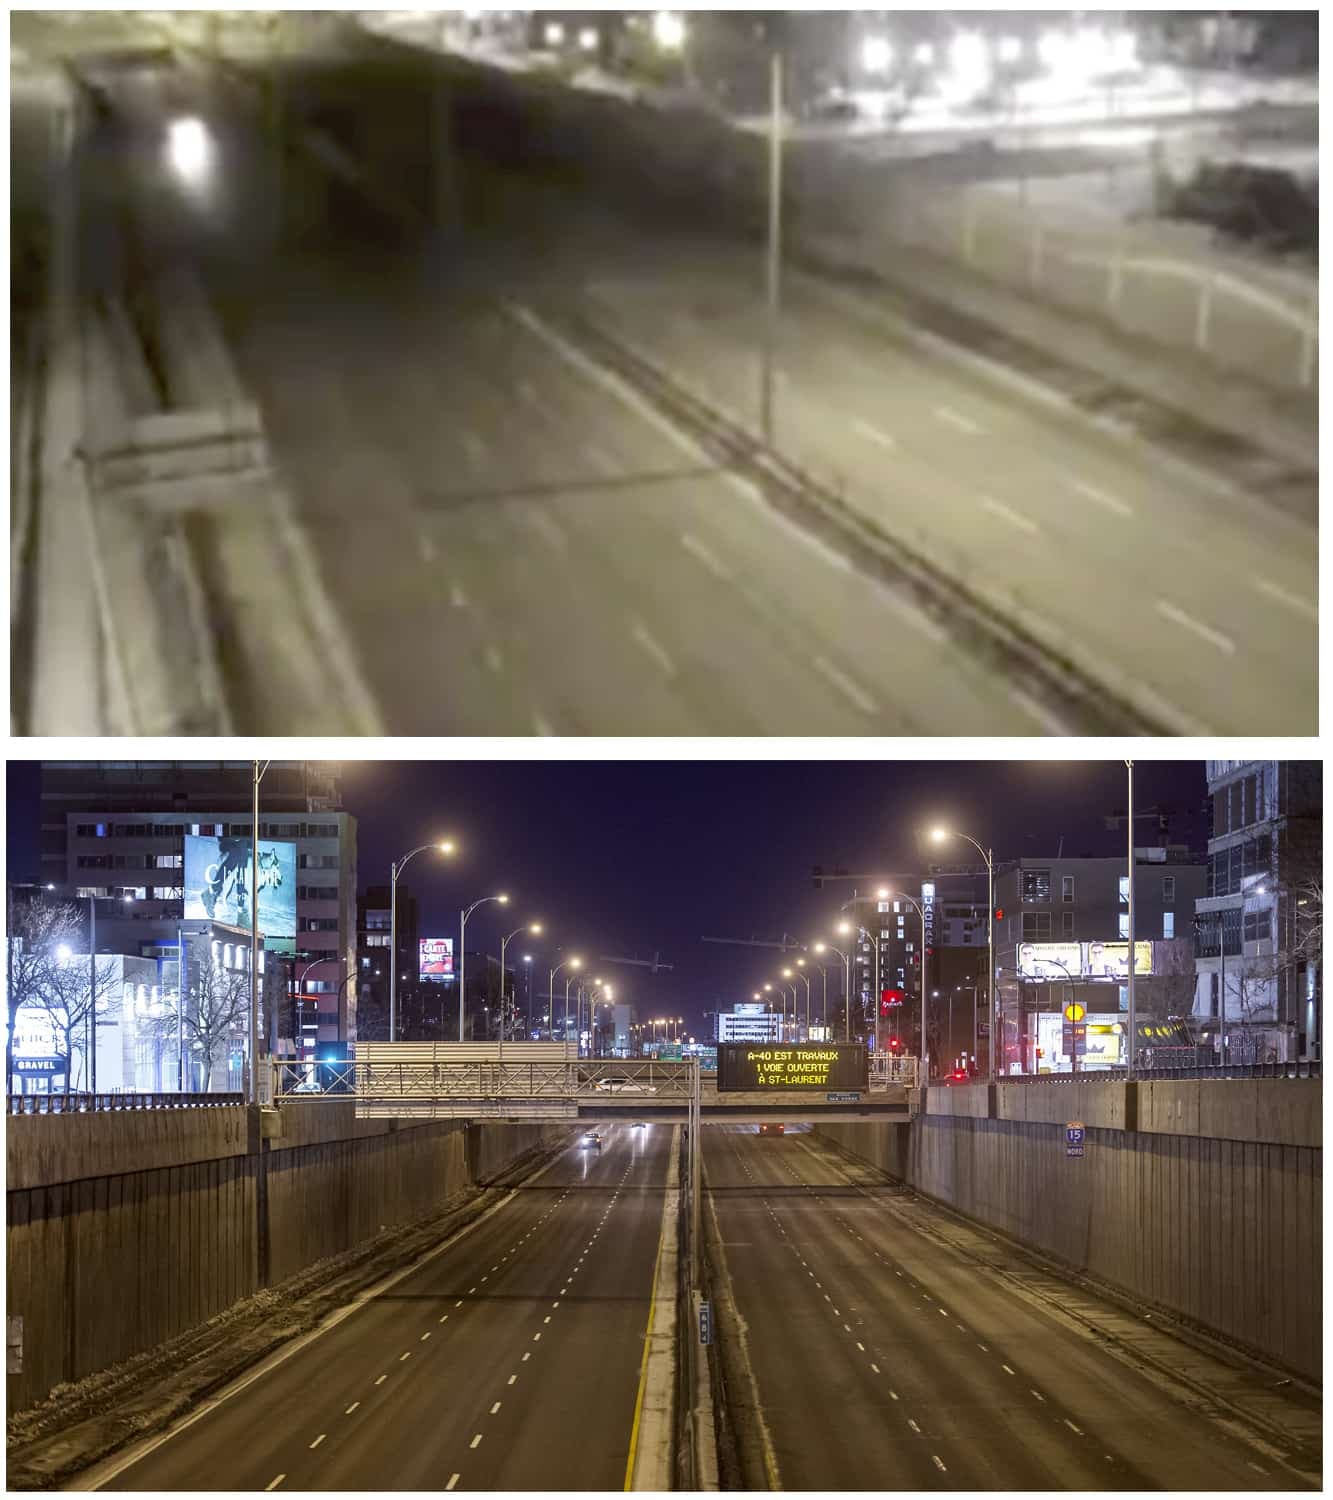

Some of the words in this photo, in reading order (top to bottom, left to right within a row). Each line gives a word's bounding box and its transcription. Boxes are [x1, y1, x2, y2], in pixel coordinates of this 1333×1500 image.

[747, 1051, 772, 1061] A-40
[774, 1051, 793, 1061] EST
[797, 1051, 839, 1061] TRAVAUX
[17, 1061, 56, 1070] GRAVEL
[764, 1063, 784, 1072] VOIE
[787, 1063, 830, 1073] OUVERTE
[768, 1075, 828, 1084] ST-LAURENT
[1069, 1129, 1081, 1140] 15
